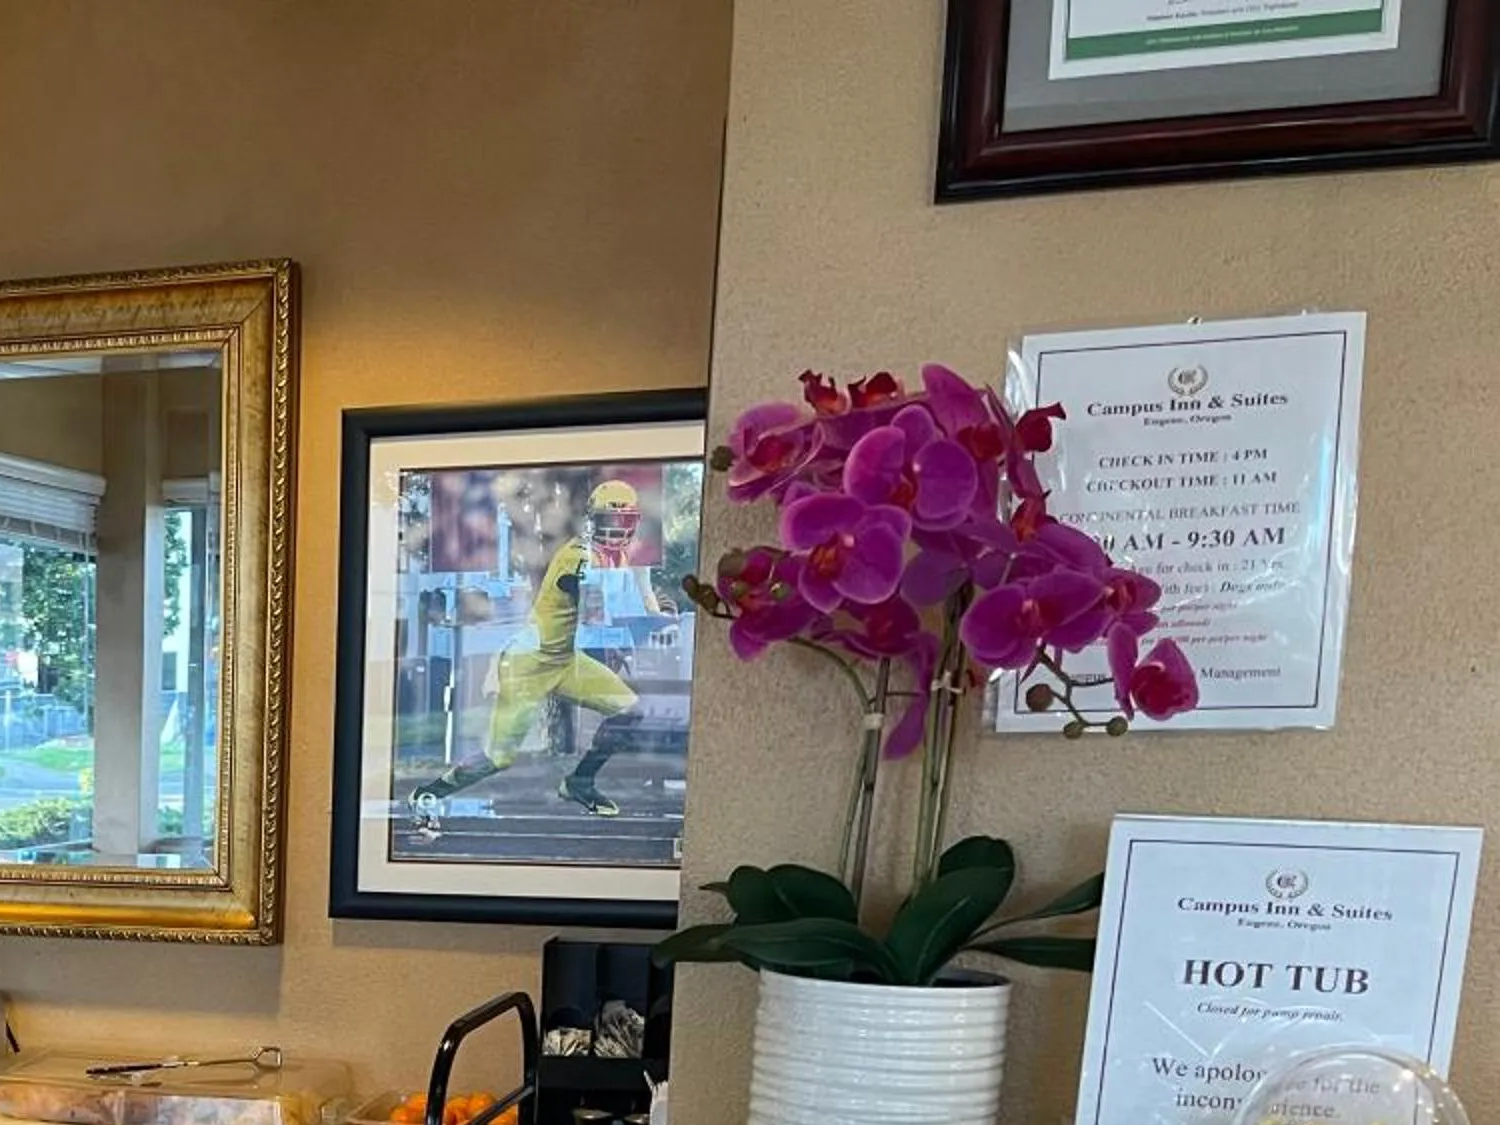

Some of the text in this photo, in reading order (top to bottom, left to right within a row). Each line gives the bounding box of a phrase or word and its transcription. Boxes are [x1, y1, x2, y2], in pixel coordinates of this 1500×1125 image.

[1087, 391, 1289, 418] Campus Inn & Suites
[1099, 451, 1153, 469] CHECK
[1156, 452, 1174, 466] IN
[1178, 450, 1219, 465] TIME
[1242, 447, 1268, 461] PM
[1086, 476, 1174, 493] CHECKOUT
[1178, 474, 1217, 489] TIME
[1251, 470, 1278, 484] AM
[1168, 503, 1258, 521] BREAKFAST
[1264, 501, 1300, 515] TIME
[1123, 532, 1164, 551] AM
[1187, 528, 1236, 549] 9:30
[1242, 526, 1286, 547] AM
[1201, 667, 1281, 681] Management
[1178, 897, 1393, 922] Campus Inn & Suites
[1183, 958, 1370, 995] HOT TUB
[1197, 1002, 1239, 1016] Closed
[1240, 1005, 1261, 1018] for
[1152, 1057, 1188, 1078] We
